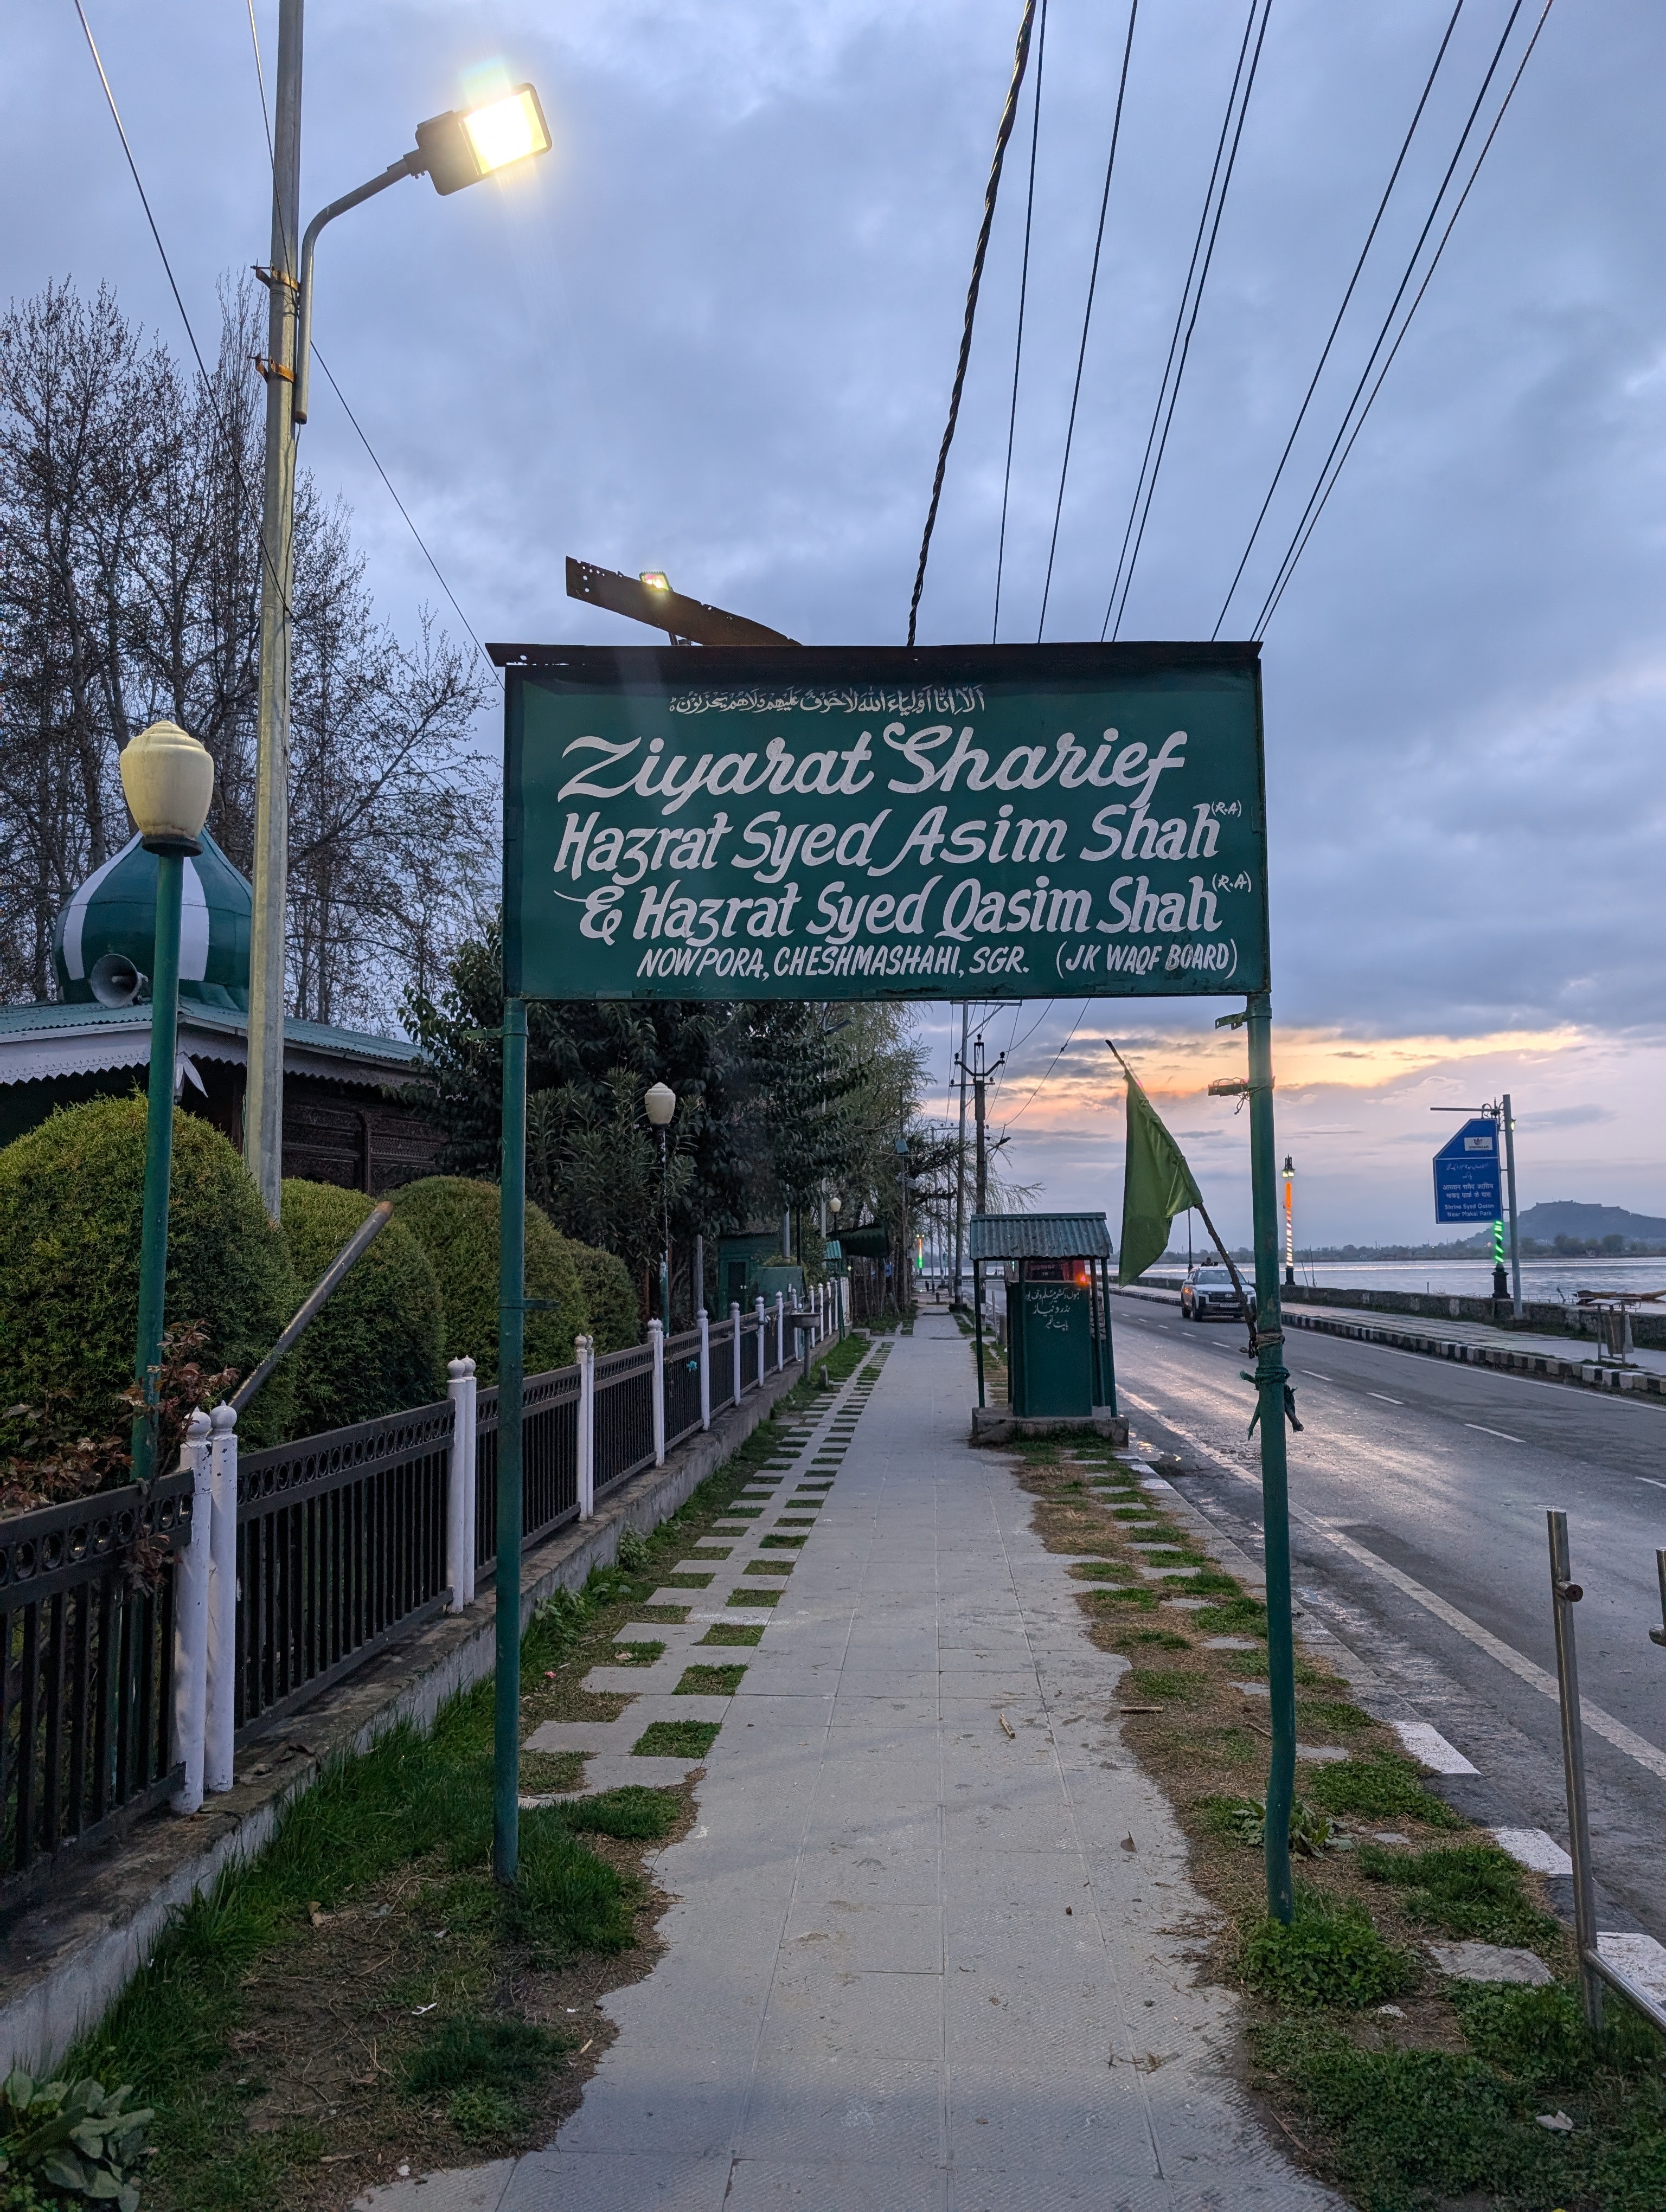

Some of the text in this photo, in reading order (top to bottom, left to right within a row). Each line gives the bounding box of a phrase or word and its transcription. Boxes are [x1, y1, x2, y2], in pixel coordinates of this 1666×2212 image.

[558, 722, 1187, 815] Ziyarat Sharief
[554, 812, 734, 885] Hazrat
[731, 808, 893, 883] Syed
[868, 804, 1067, 877] Asim
[1080, 802, 1220, 861] Shah
[554, 886, 624, 945] &
[633, 879, 802, 947] Hazrat
[805, 875, 943, 944] Syed
[934, 876, 1092, 942] Qasim
[1096, 876, 1222, 933] Shah
[773, 945, 964, 978] CHESHMASHAHI,
[969, 946, 1029, 974] SGR.
[1056, 941, 1101, 978] (JK
[1107, 944, 1162, 975] WAQF
[1164, 938, 1238, 980] BOARD)
